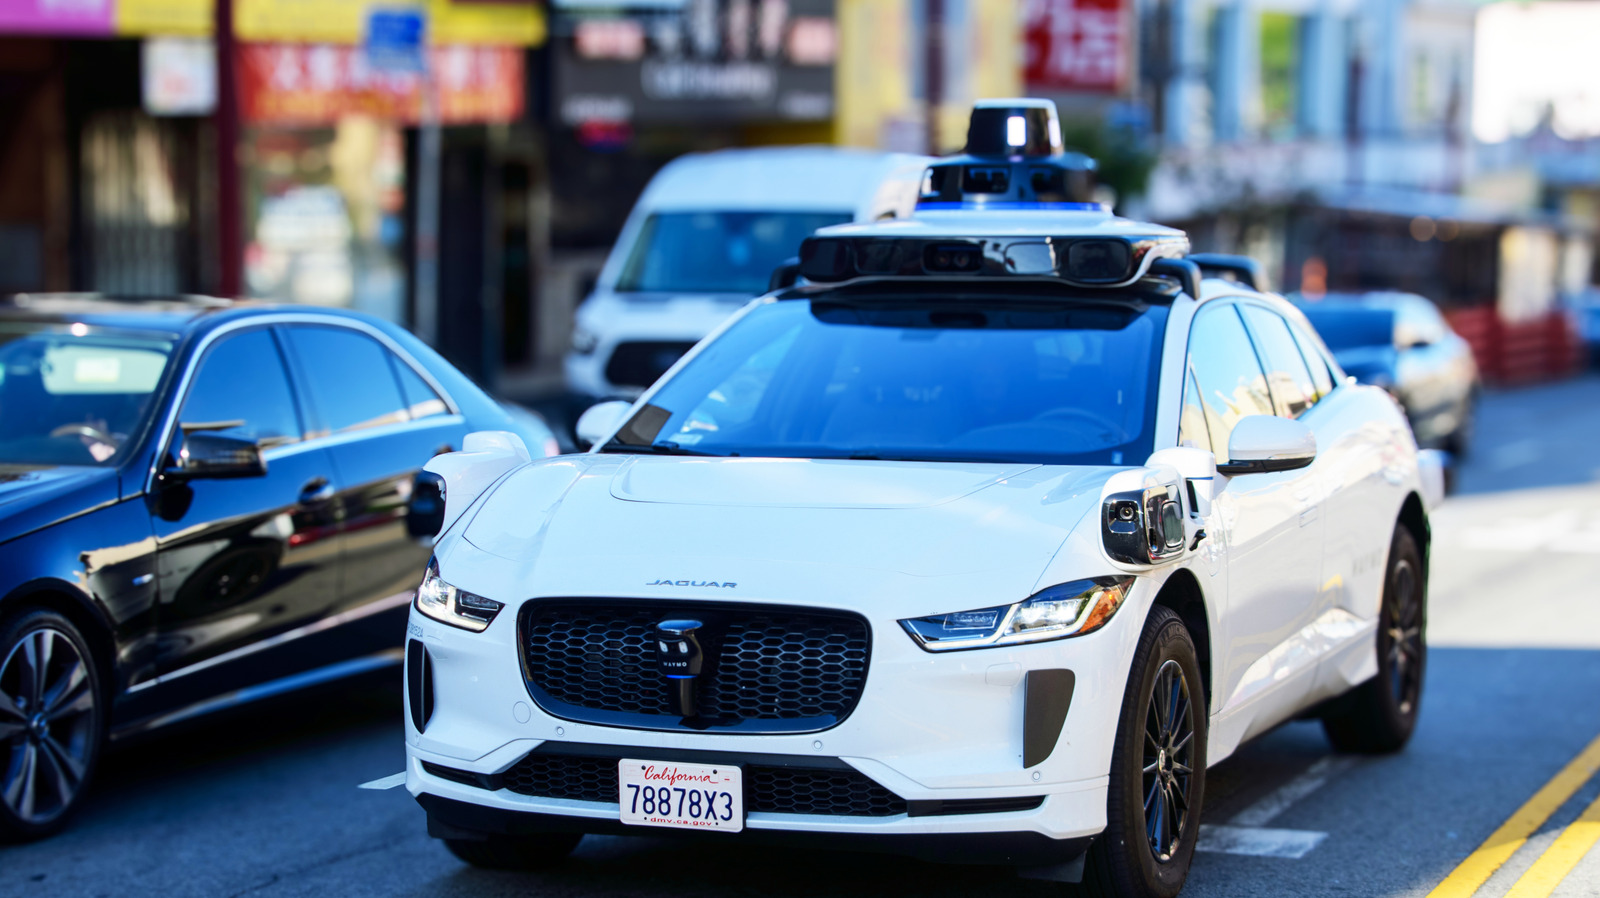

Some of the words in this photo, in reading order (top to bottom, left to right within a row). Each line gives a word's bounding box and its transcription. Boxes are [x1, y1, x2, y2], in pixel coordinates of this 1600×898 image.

[646, 579, 738, 589] JAGUAR
[644, 765, 719, 786] California
[627, 783, 733, 821] 78878X3
[650, 817, 712, 826] dmv.ca.gov
